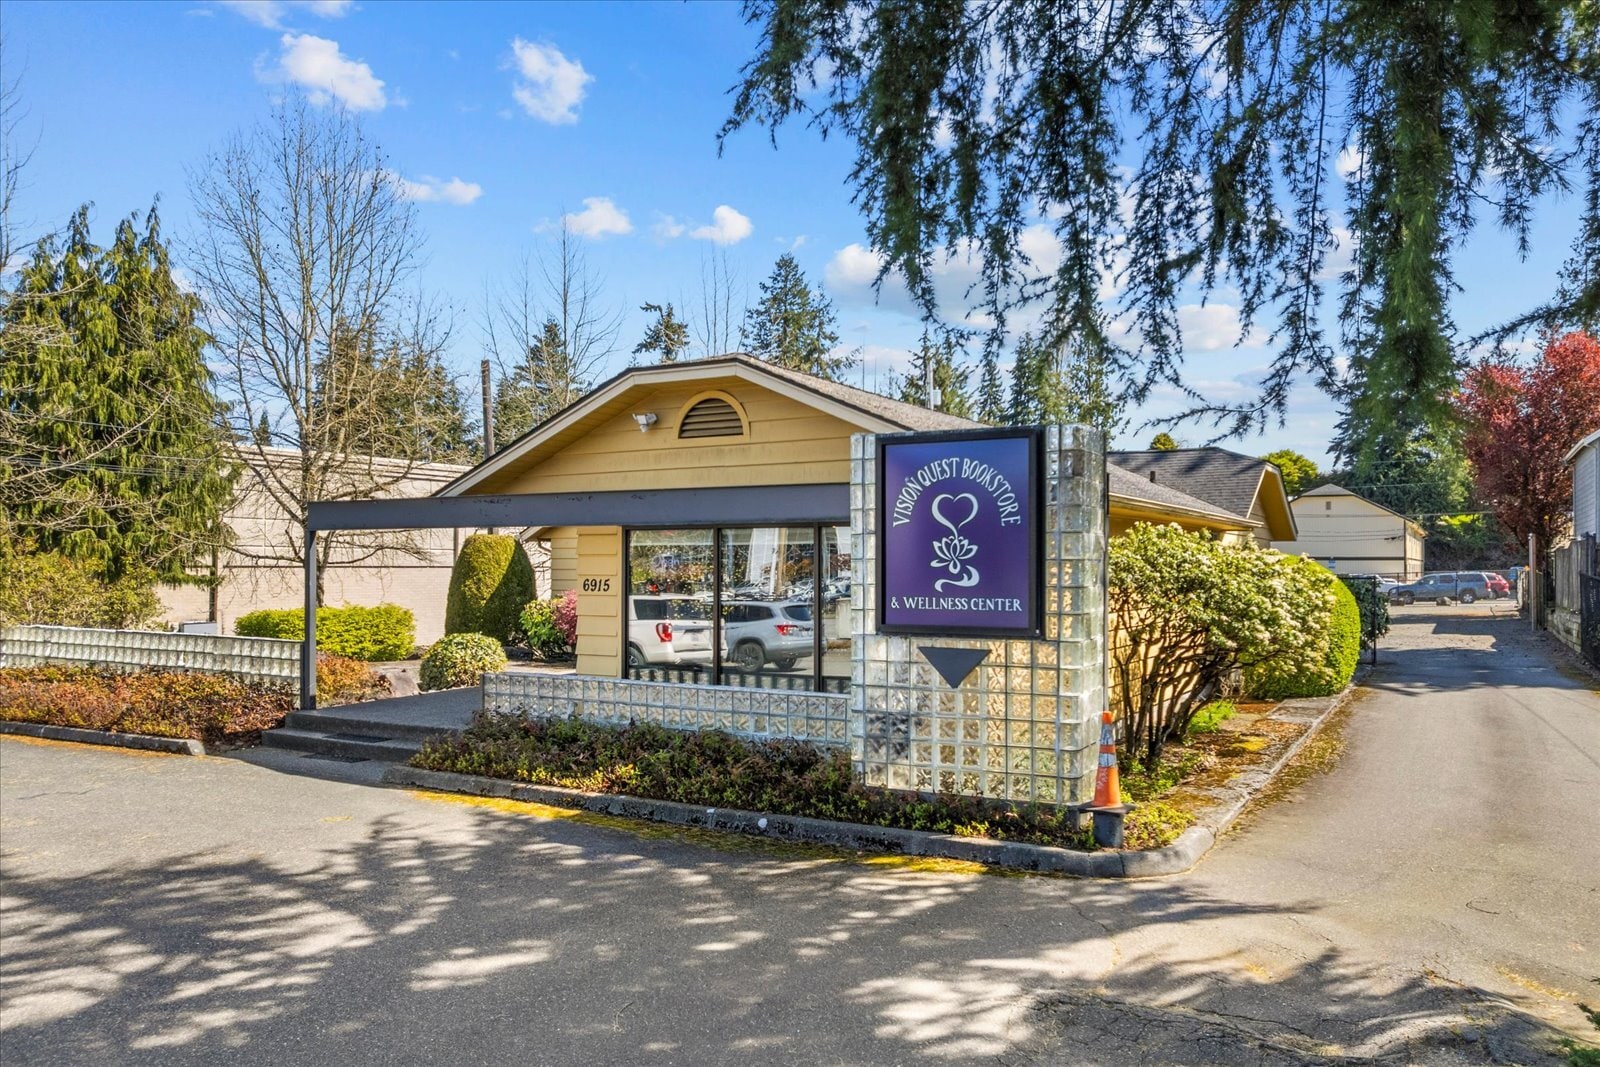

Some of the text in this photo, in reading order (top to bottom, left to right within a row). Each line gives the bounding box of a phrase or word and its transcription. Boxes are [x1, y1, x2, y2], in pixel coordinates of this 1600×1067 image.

[893, 457, 1021, 528] VISION QUEST BOOKSTORE
[583, 578, 610, 592] 6915
[890, 596, 1022, 611] & WELLNESS CENTER
